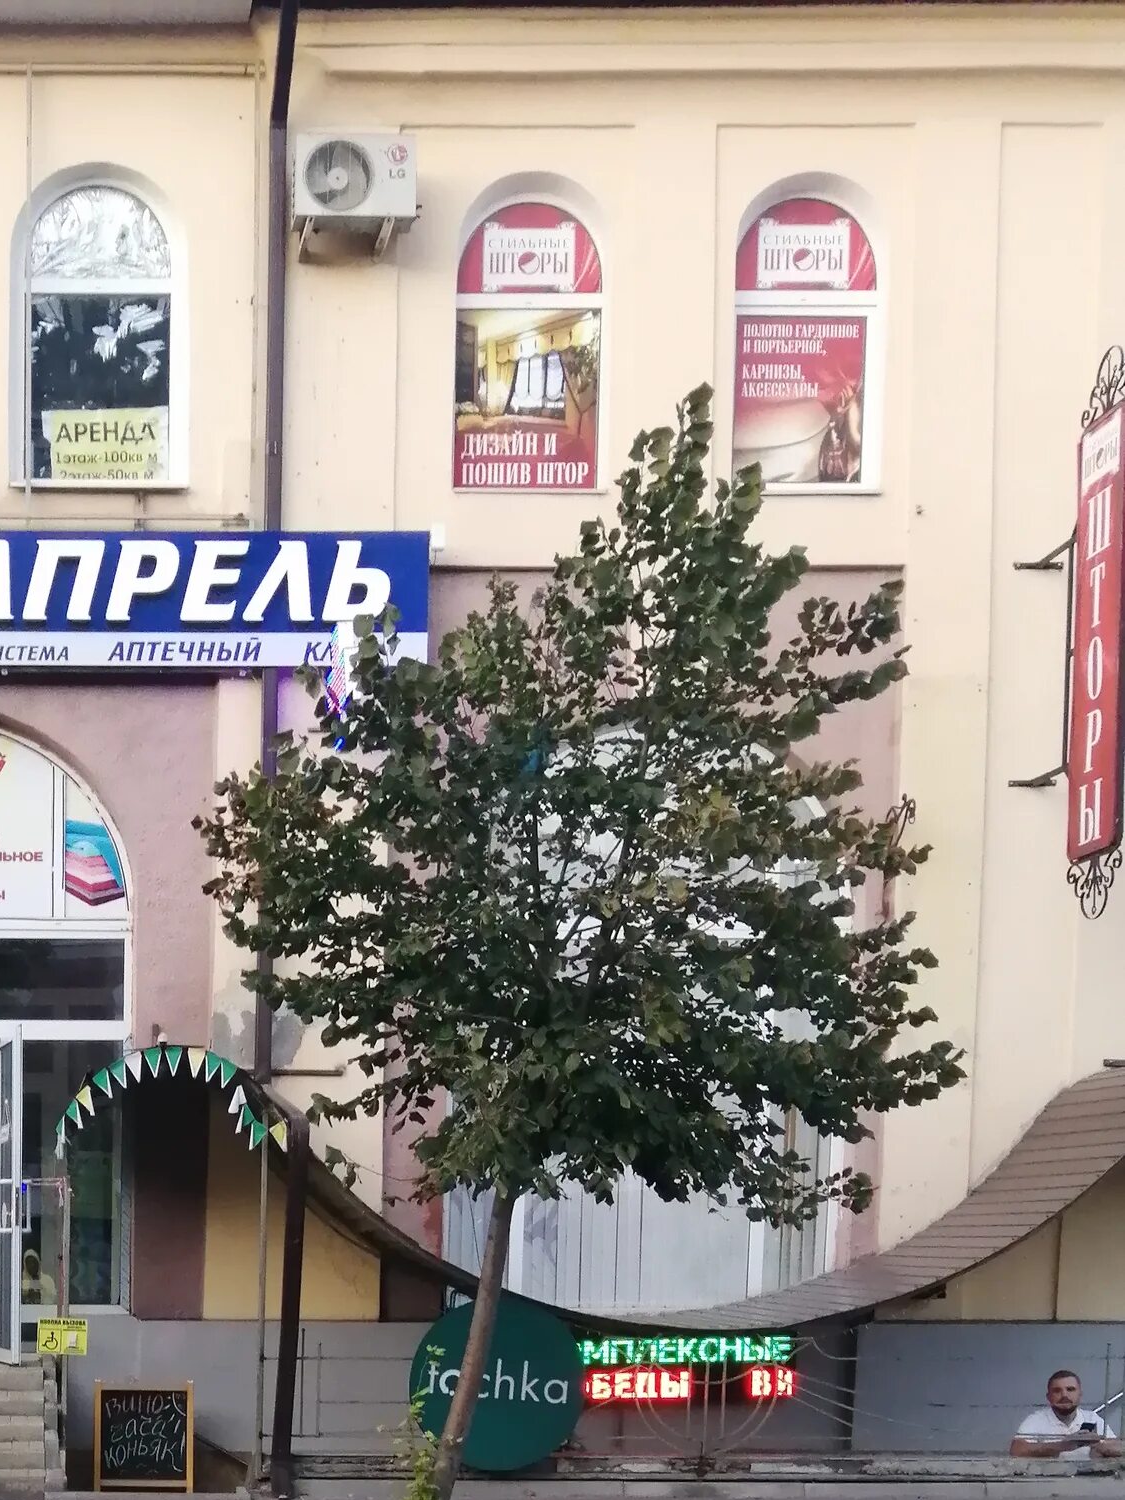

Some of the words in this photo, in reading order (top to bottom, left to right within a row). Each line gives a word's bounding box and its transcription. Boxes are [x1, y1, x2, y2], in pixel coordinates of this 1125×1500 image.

[389, 168, 405, 179] LG
[488, 238, 570, 248] СТИЛЬНЫЕ
[763, 235, 843, 245] СТИЛЬНЫЕ
[489, 251, 569, 275] ШТОРЫ
[764, 248, 843, 271] ШТОРЫ
[743, 324, 793, 338] ПОЛОТНО
[795, 324, 860, 339] ГАРДИННОЕ
[743, 340, 751, 354] И
[754, 339, 827, 356] ПОРТЬЕРНОЕ,
[742, 364, 805, 381] КАРНИЗЫ,
[741, 382, 819, 398] АКСЕССУАРЫ
[56, 421, 156, 445] АРЕНДА
[461, 430, 538, 459] ДИЗАЙН
[544, 433, 557, 455] И
[462, 462, 531, 485] ПОШИВ
[536, 461, 589, 485] ШТОР
[108, 637, 261, 662] АПТЕЧНЫЙ
[1078, 484, 1113, 846] ШТОРЫ
[576, 1337, 792, 1365] МПЛЕКСНЫЕ
[586, 1370, 690, 1399] БЕДЫ
